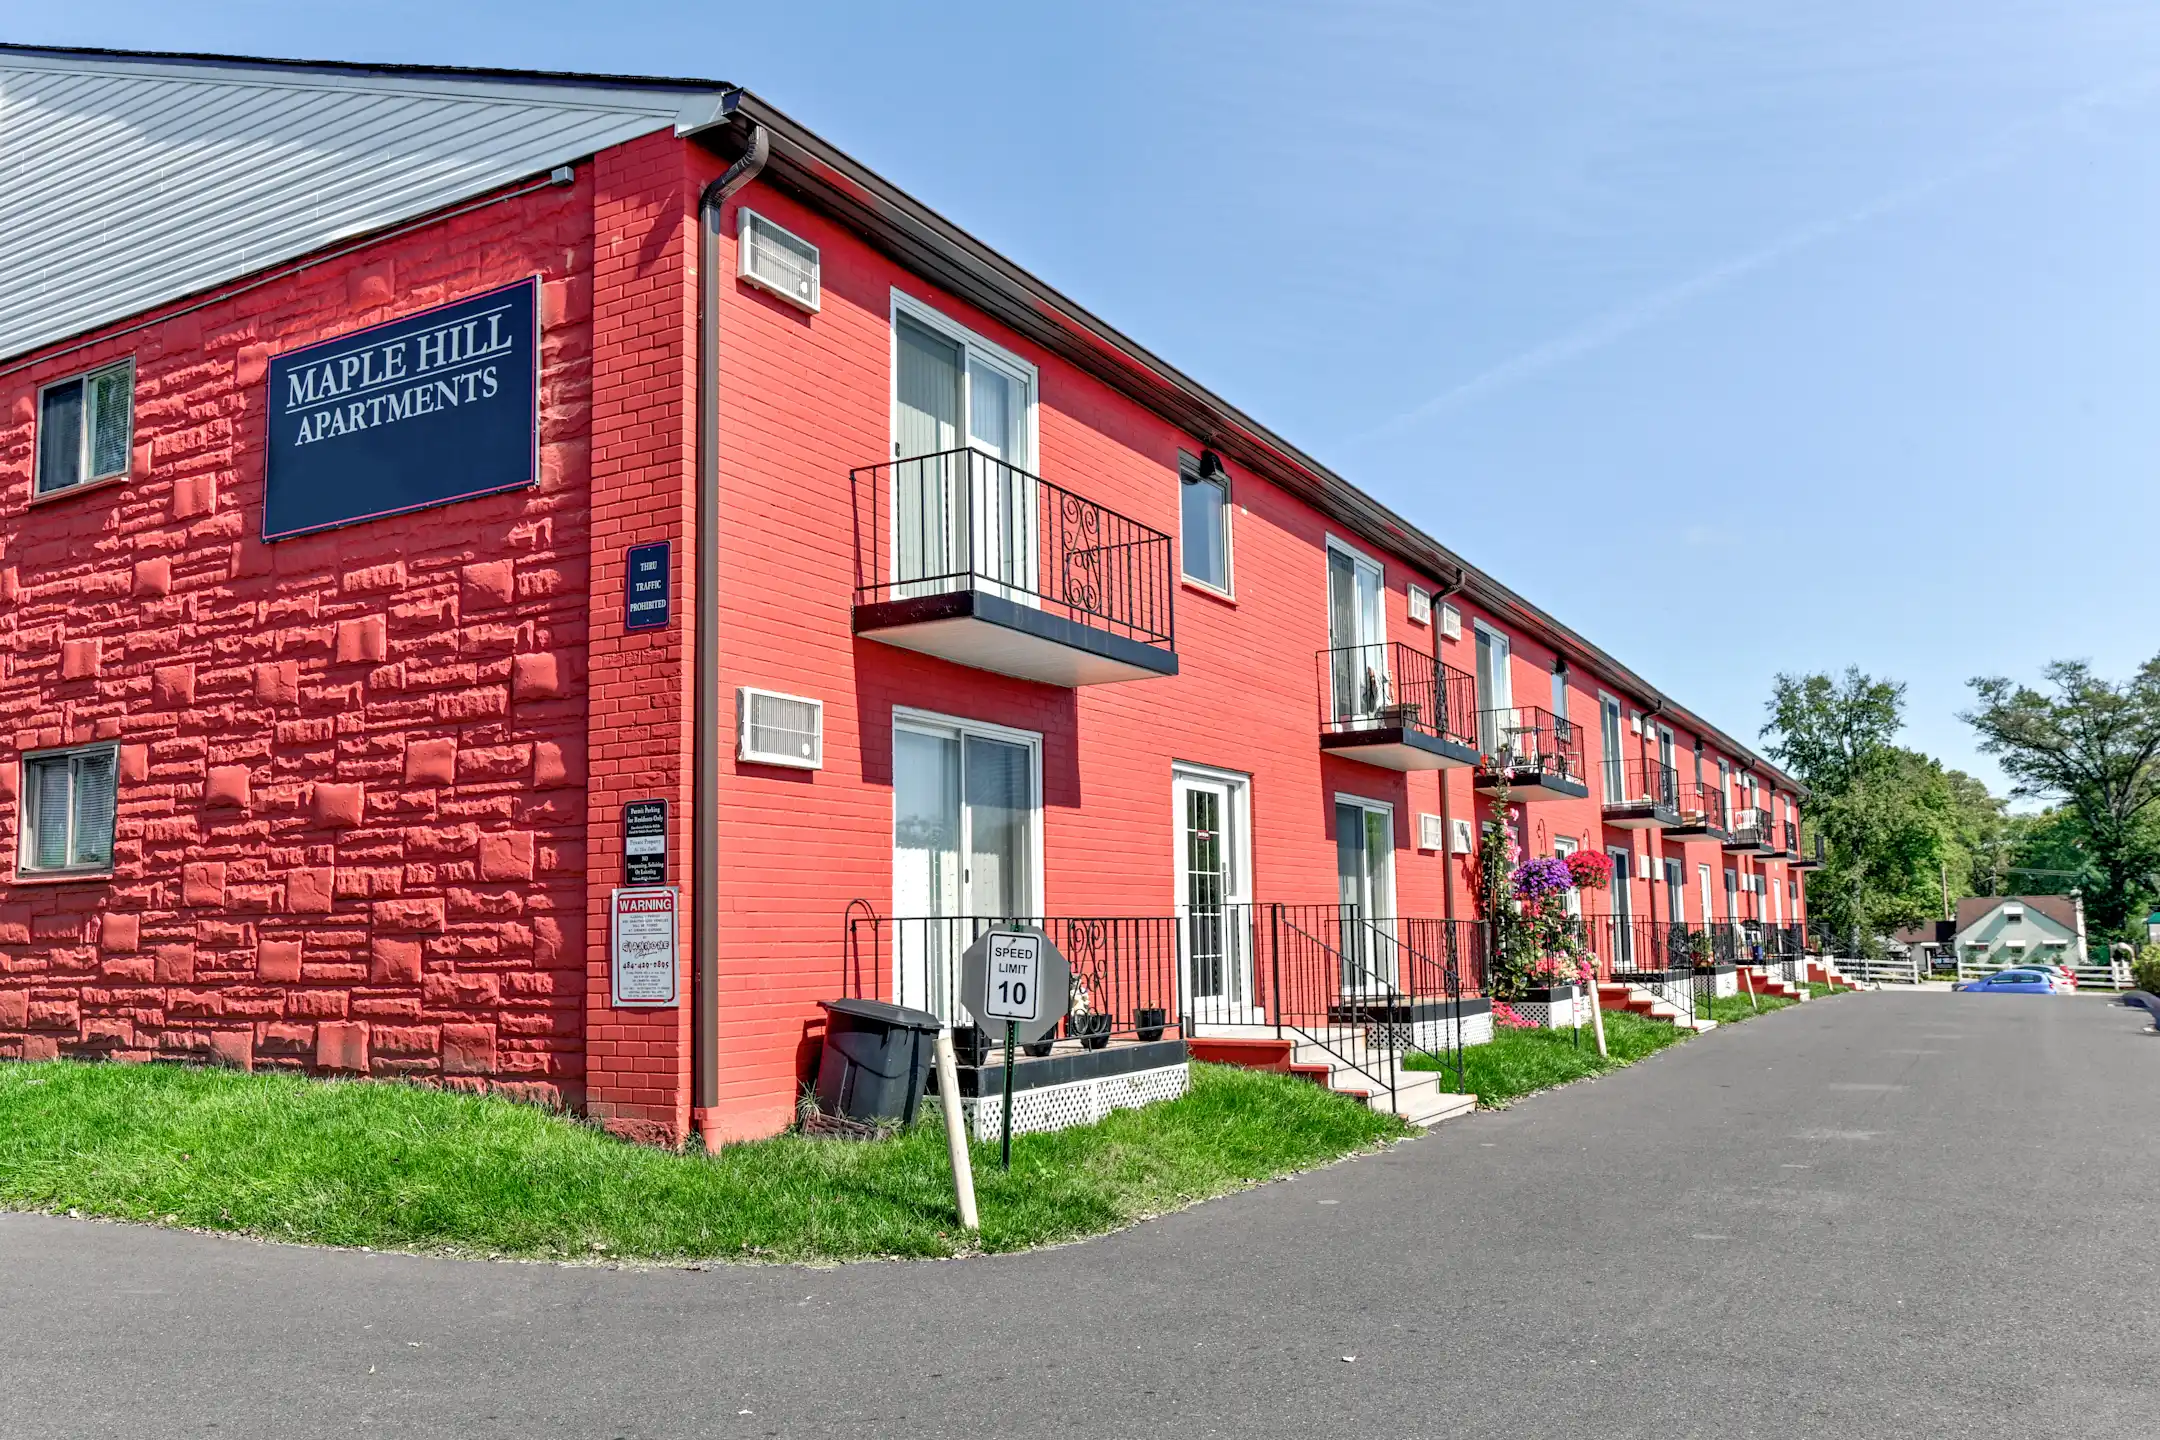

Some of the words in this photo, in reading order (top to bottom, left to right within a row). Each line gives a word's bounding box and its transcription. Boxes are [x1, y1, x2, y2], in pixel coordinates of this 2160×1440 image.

[286, 342, 407, 408] MAPLE
[416, 313, 512, 372] HILL
[294, 366, 499, 446] APARTMENTS
[640, 560, 658, 572] THRU
[635, 580, 662, 592] TRAFFIC
[630, 599, 667, 613] PROHIBITED
[644, 806, 660, 814] Parking
[619, 898, 672, 911] WARNING
[995, 947, 1033, 959] SPEED
[998, 963, 1028, 974] LIMIT
[998, 980, 1027, 1005] 10
